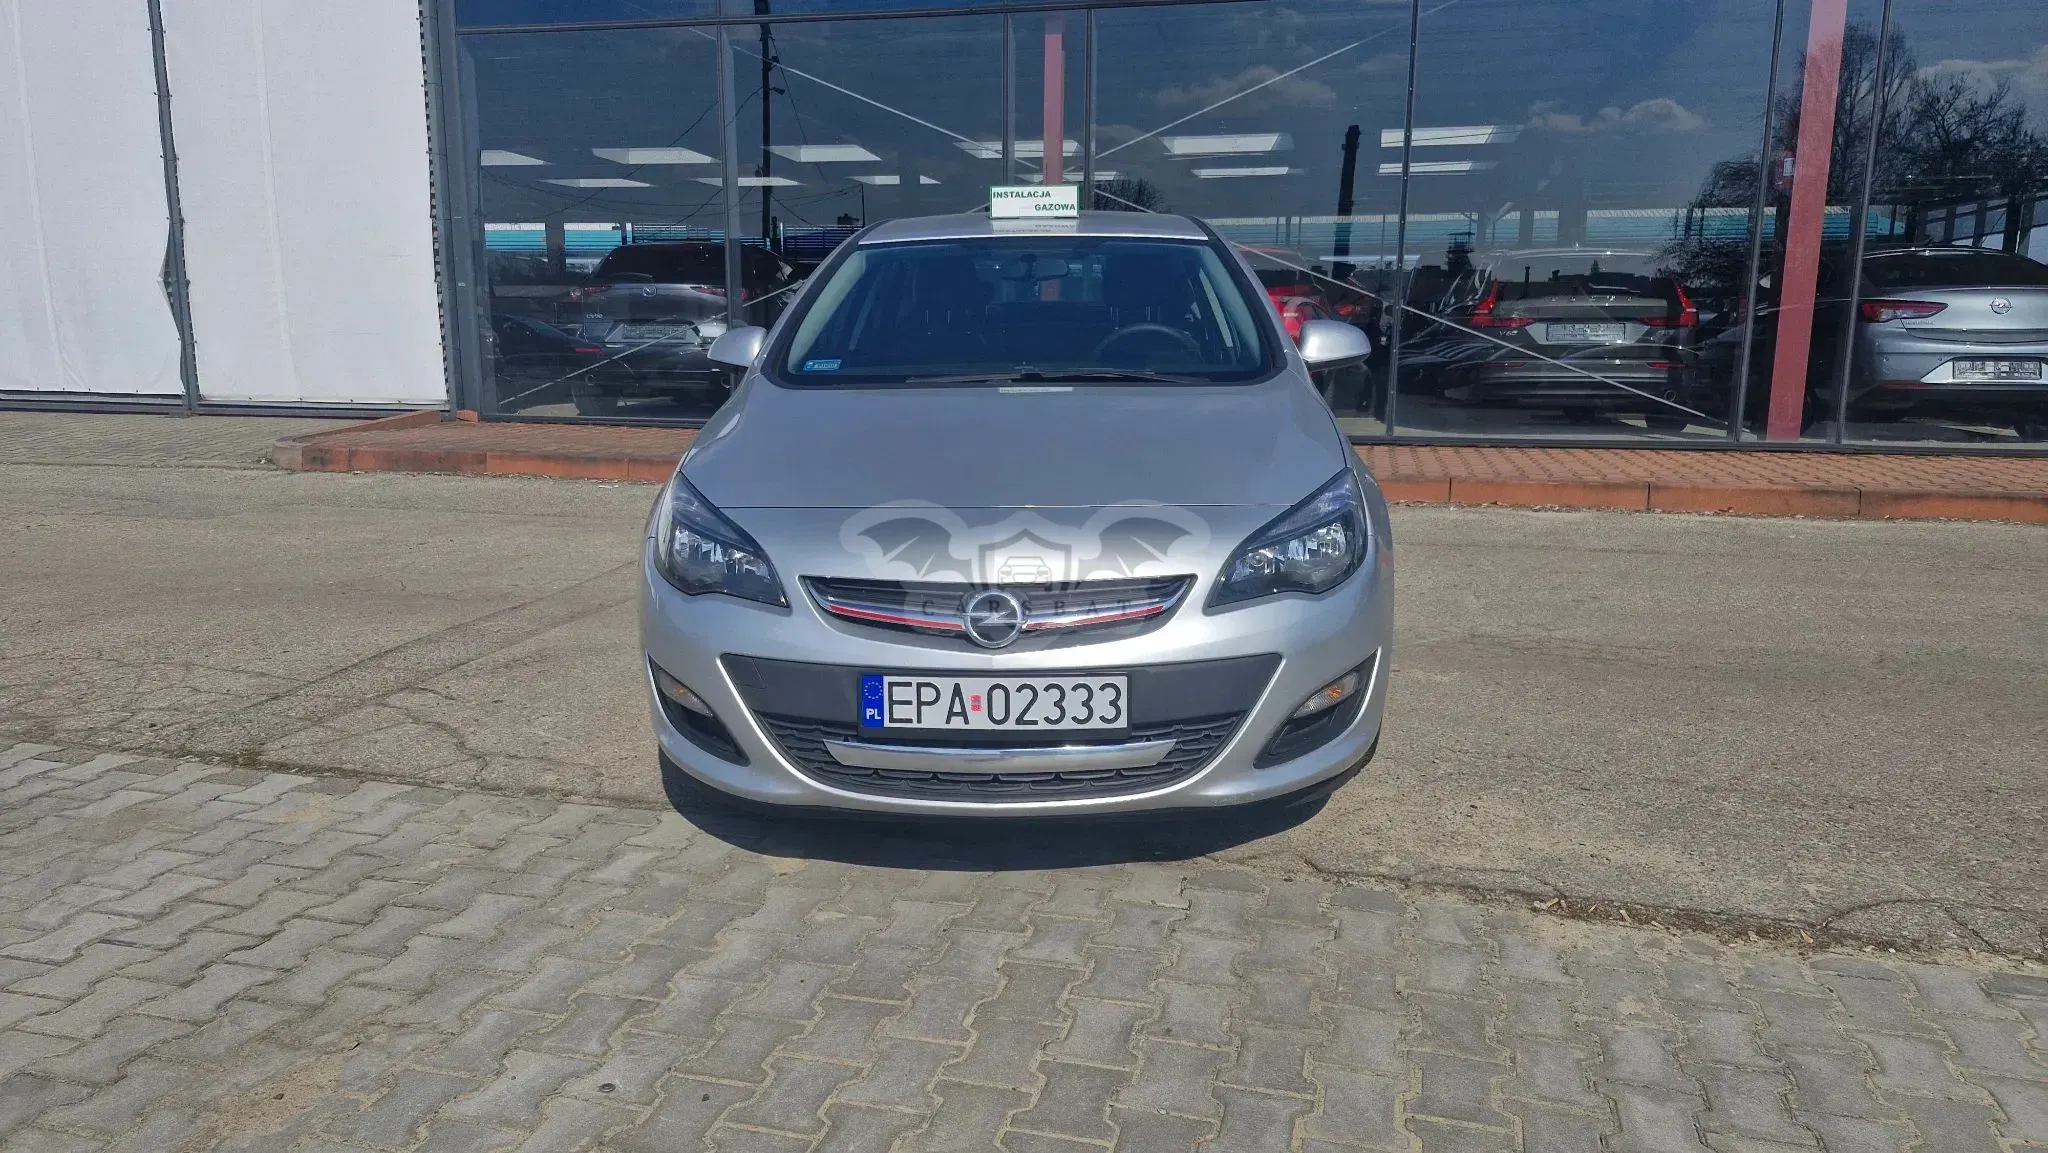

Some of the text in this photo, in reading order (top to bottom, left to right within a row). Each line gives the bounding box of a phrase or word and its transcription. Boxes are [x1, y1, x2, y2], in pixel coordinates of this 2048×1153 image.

[866, 708, 881, 719] PL
[887, 681, 1122, 726] EPA 02333
